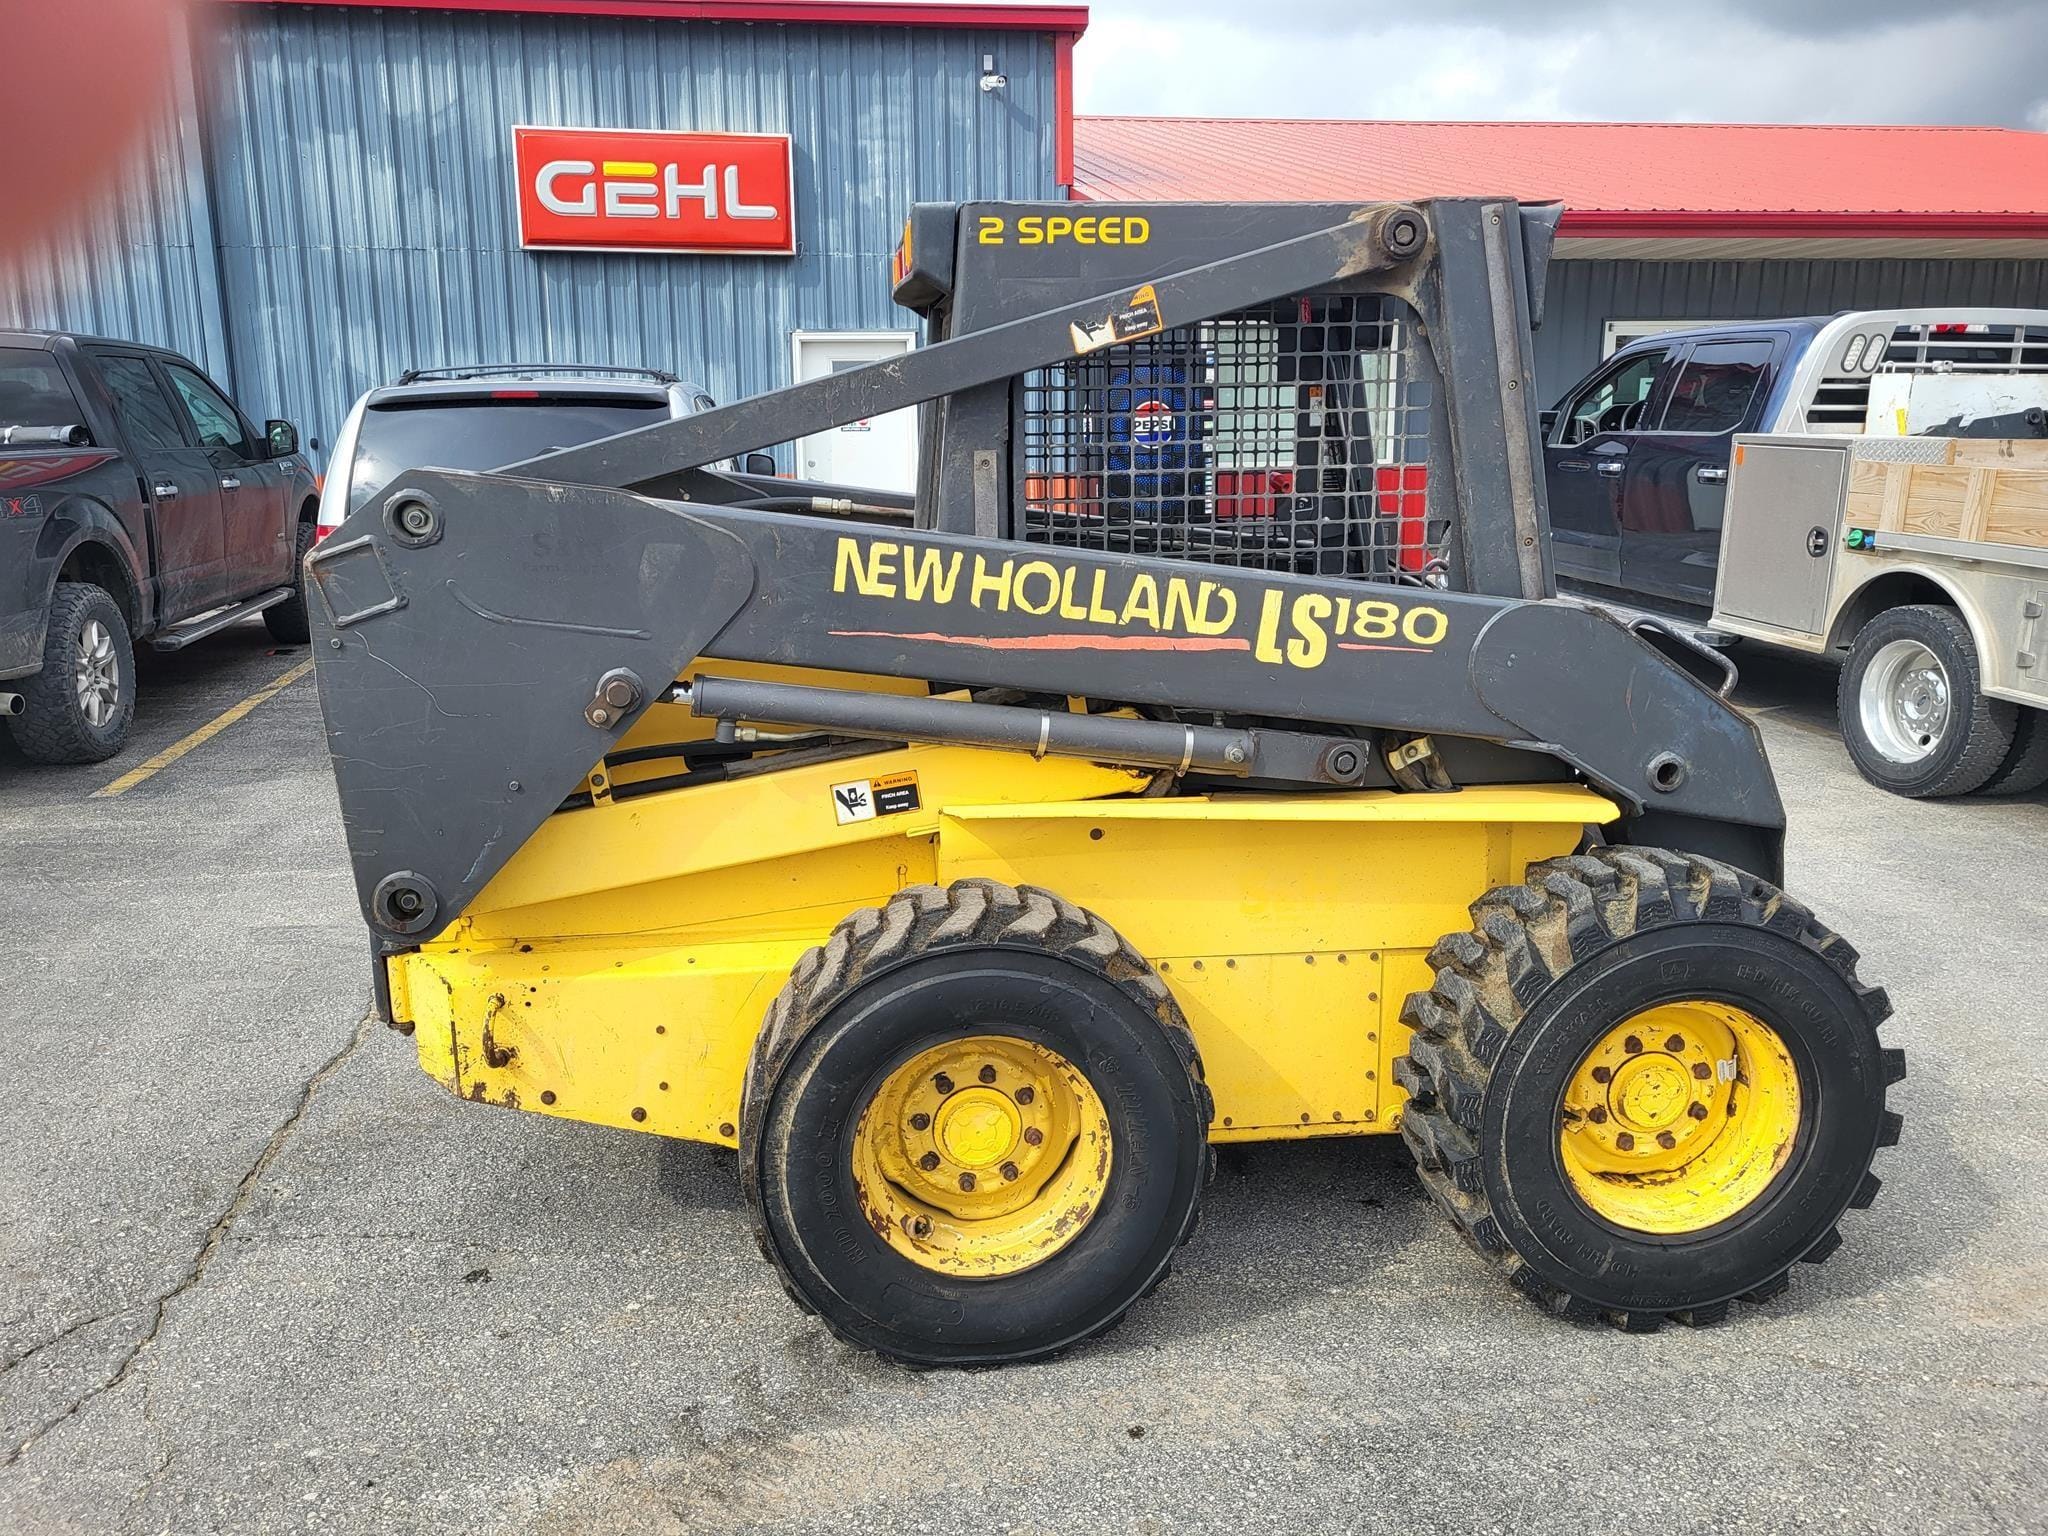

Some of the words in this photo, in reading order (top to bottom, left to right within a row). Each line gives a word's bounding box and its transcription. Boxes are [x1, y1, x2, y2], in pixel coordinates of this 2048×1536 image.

[534, 159, 778, 220] GEHL
[978, 216, 1005, 244] 2
[1017, 216, 1149, 244] SPEED
[1134, 419, 1173, 430] PEPSI
[832, 537, 964, 604] NEW
[970, 554, 1238, 636] HOLLAND
[883, 777, 912, 785] WARNING
[1113, 1082, 1151, 1177] TITAN
